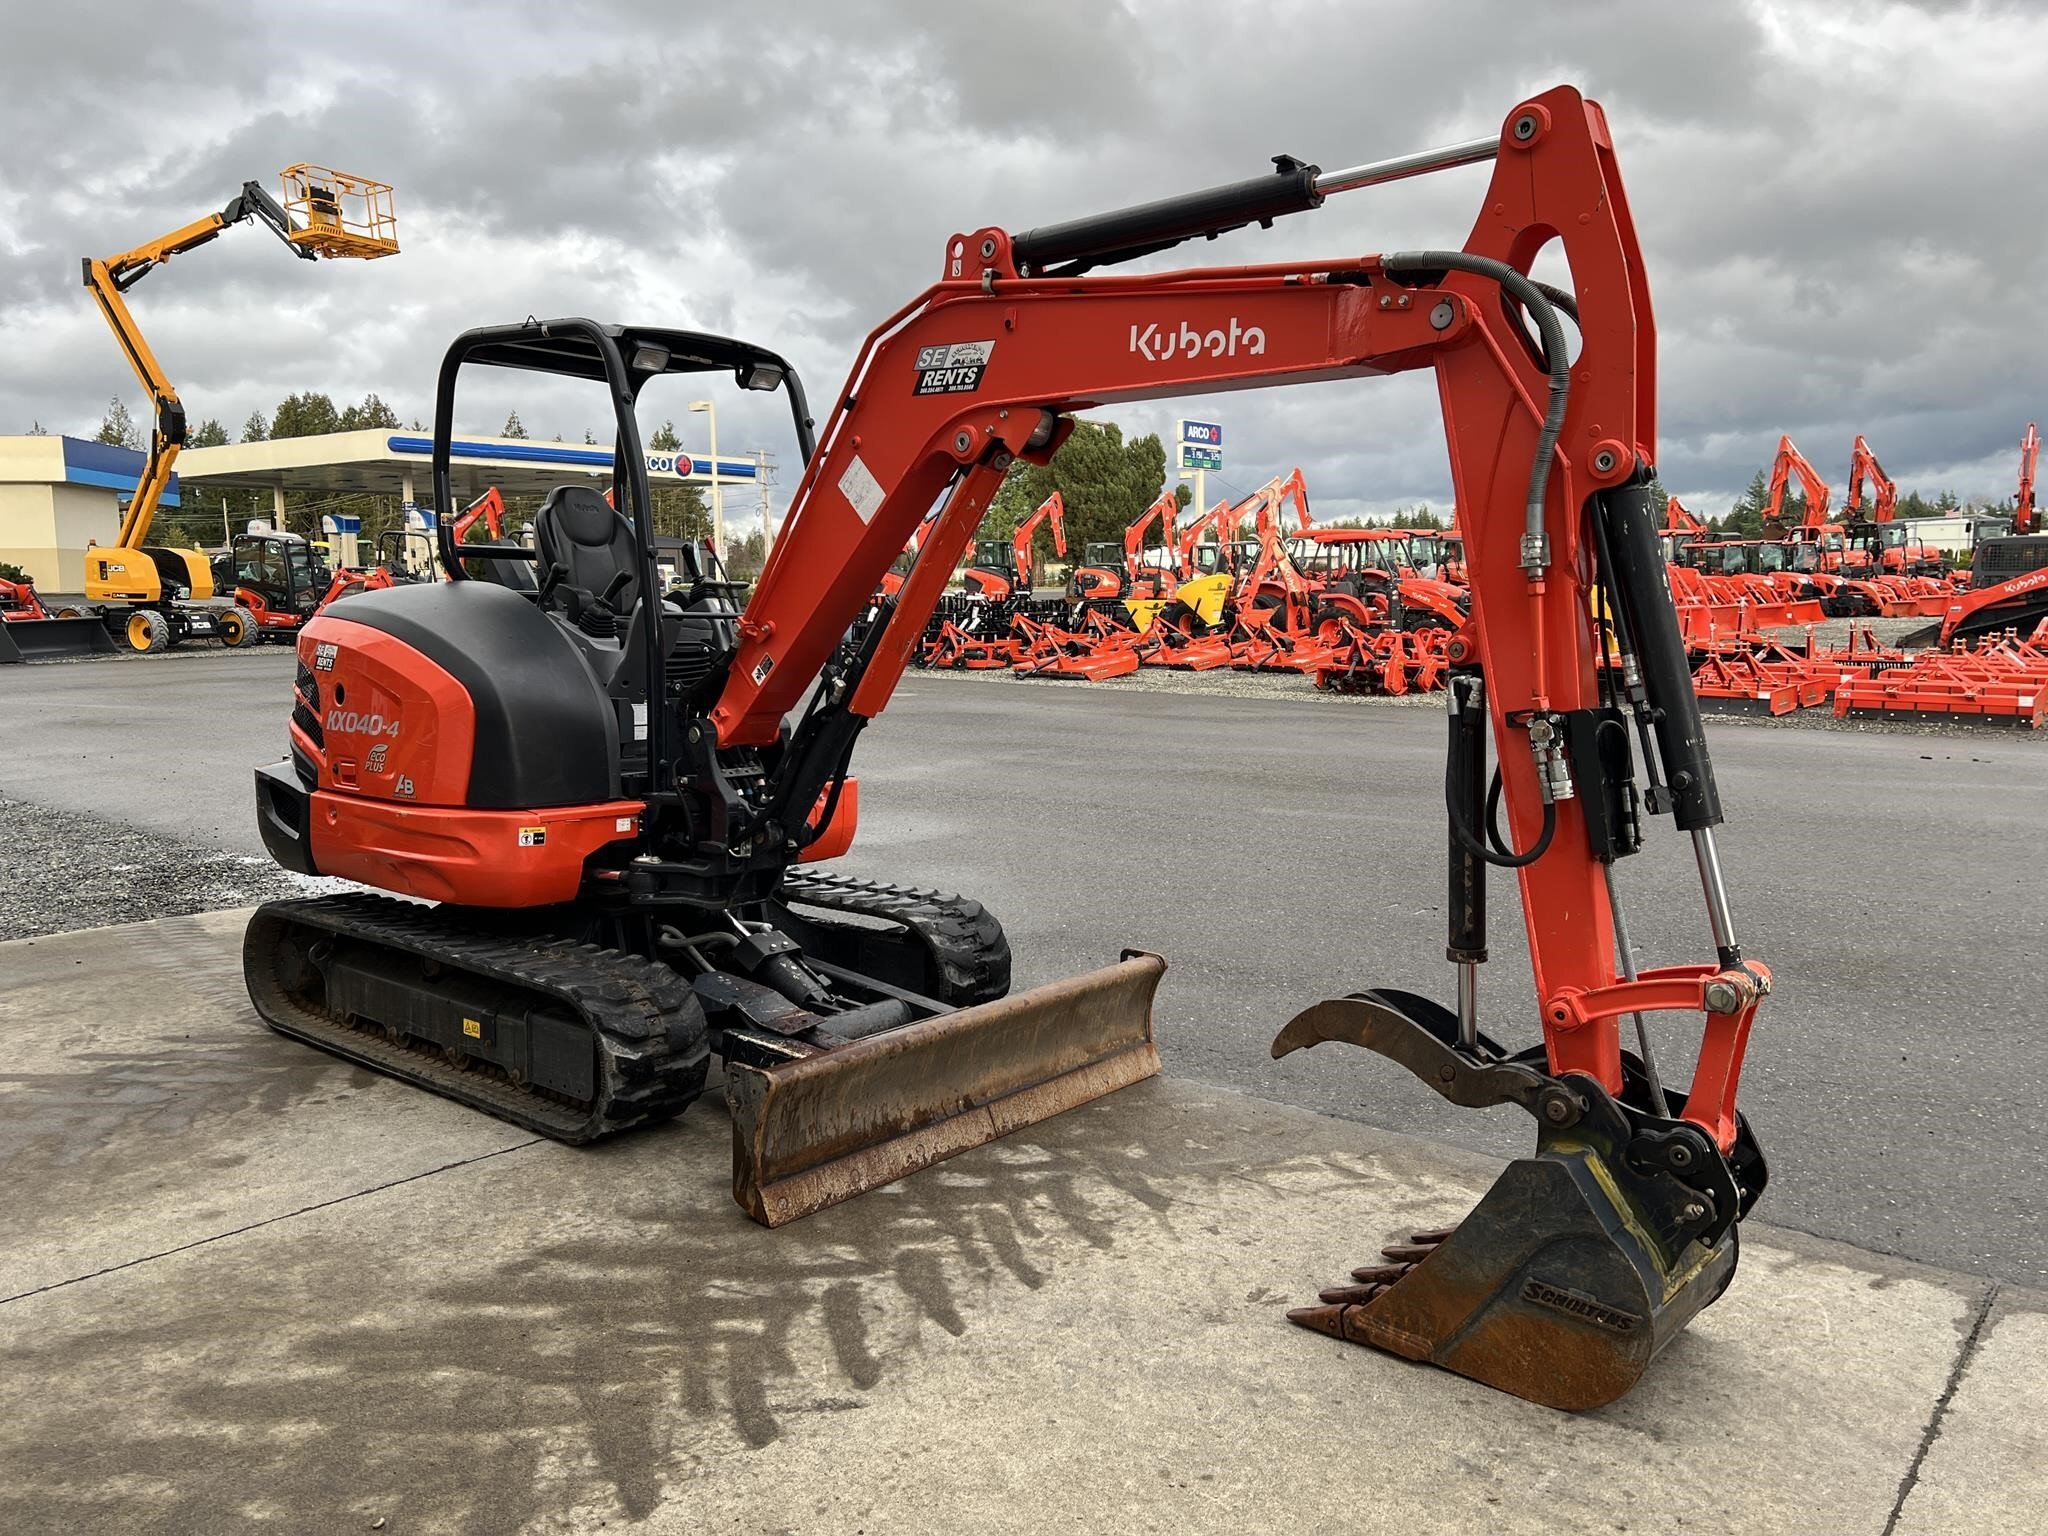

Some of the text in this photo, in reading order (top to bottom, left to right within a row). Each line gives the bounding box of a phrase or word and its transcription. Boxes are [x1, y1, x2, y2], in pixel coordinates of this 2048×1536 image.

[1129, 317, 1266, 361] Kubota
[918, 348, 946, 368] SE
[921, 367, 978, 387] RENTS
[1188, 426, 1209, 439] ARCO
[107, 564, 125, 572] JCB
[2003, 574, 2047, 593] Kubota
[191, 621, 212, 629] JCB
[316, 656, 333, 668] RENTS
[326, 710, 400, 738] KX040-4
[364, 761, 385, 773] PLUS
